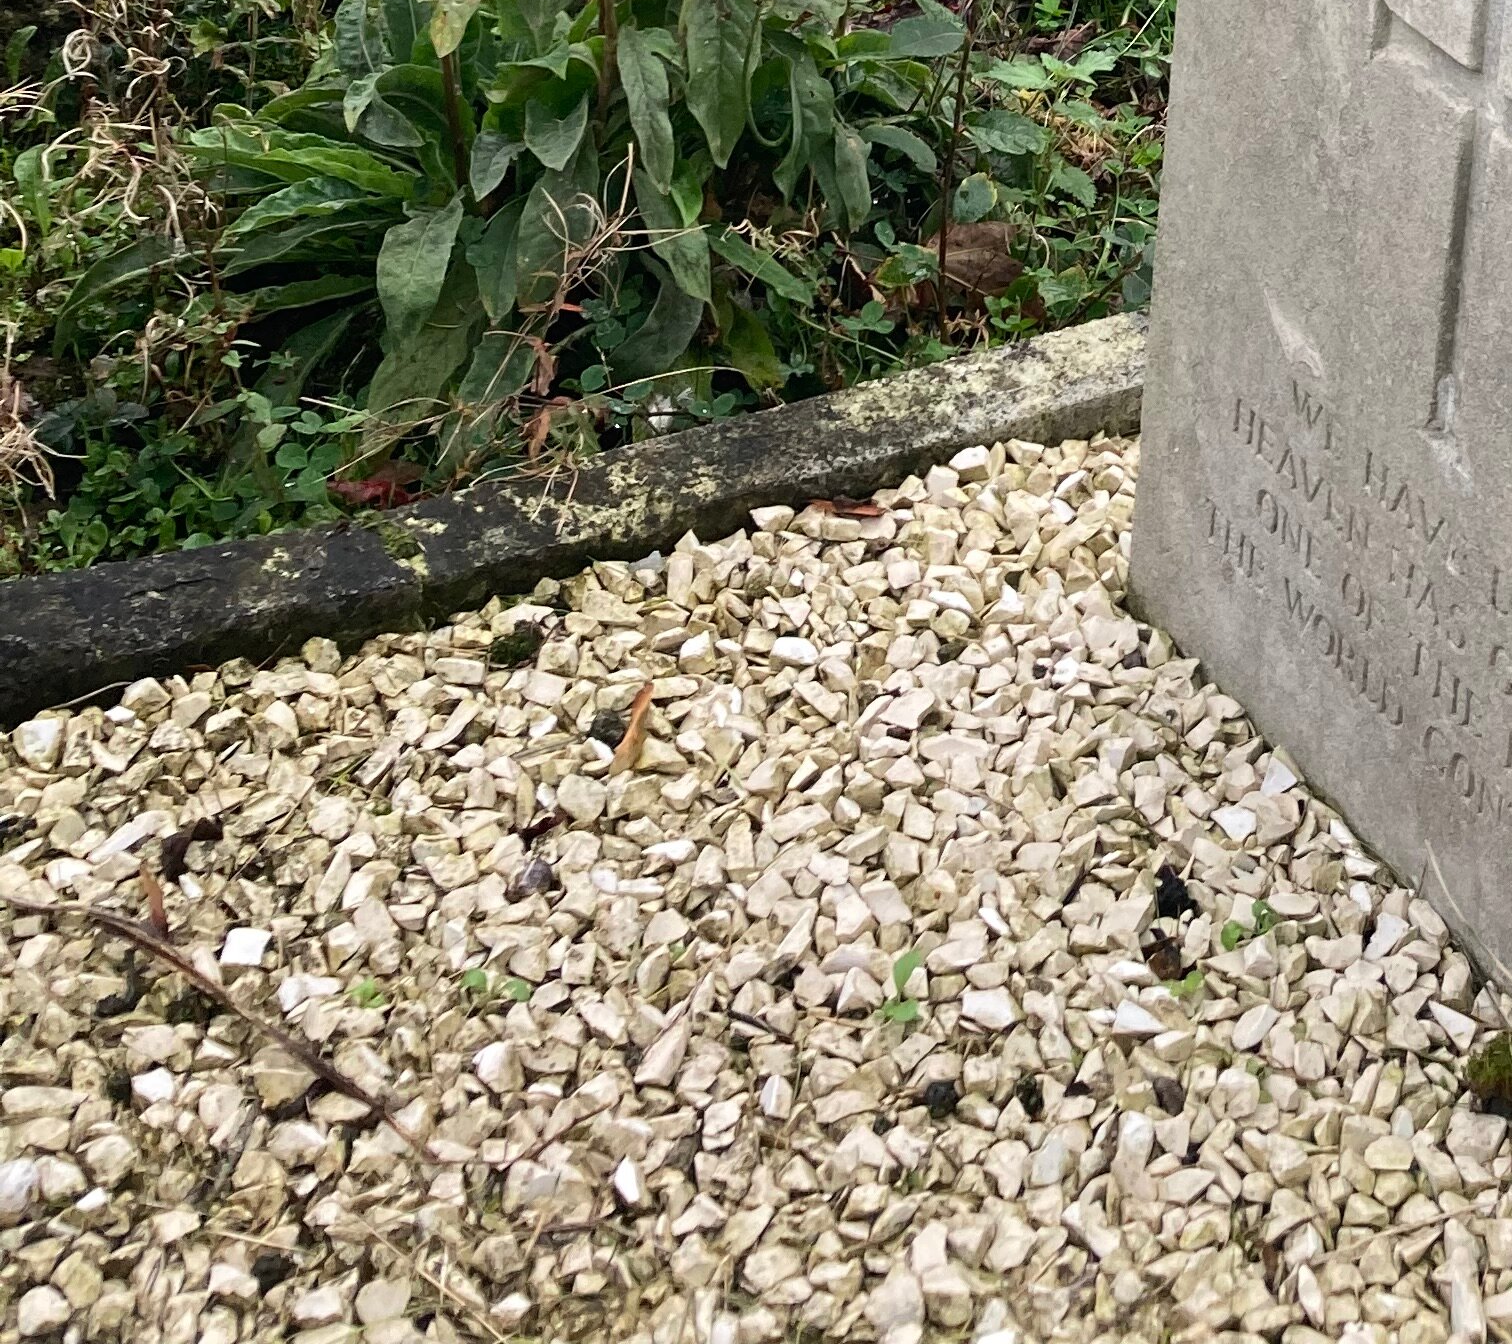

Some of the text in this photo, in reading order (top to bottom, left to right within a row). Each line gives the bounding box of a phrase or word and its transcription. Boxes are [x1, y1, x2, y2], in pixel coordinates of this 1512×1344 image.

[1231, 397, 1371, 550] HEAVEN
[1388, 544, 1467, 649] HAS
[1291, 378, 1341, 460] WE
[1363, 448, 1475, 578] HAVE
[1201, 494, 1266, 580] THE
[1283, 575, 1405, 727] WORLD
[1255, 487, 1323, 580] ONE
[1406, 630, 1483, 738] THE
